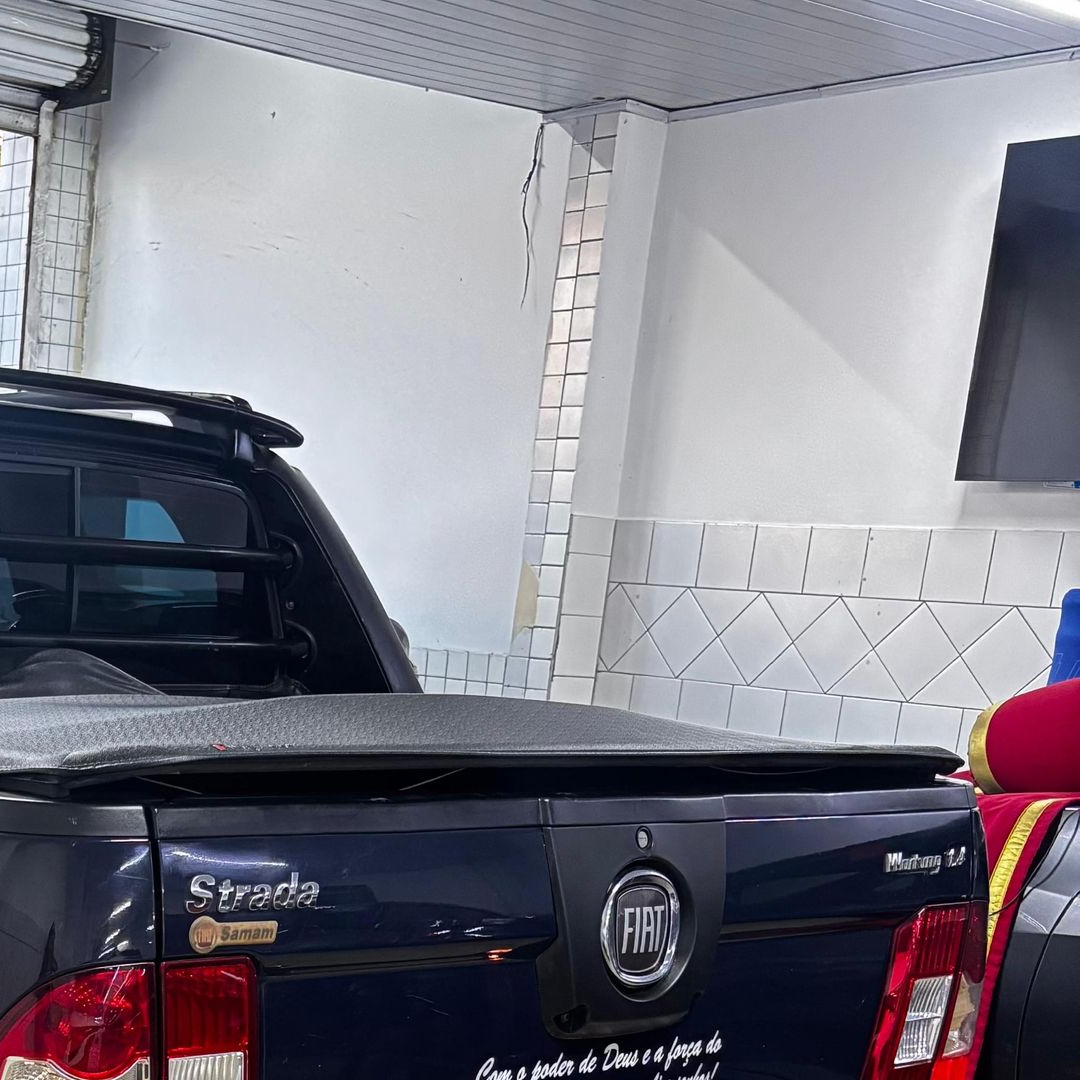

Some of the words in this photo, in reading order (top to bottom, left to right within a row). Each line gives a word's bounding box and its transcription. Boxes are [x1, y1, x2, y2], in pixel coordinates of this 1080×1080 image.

[186, 871, 320, 913] Strada
[220, 926, 274, 942] Samam
[621, 905, 665, 954] FIAT
[578, 1048, 597, 1074] de
[601, 1042, 639, 1072] Deus
[641, 1048, 651, 1066] e
[654, 1047, 664, 1063] a
[664, 1036, 703, 1072] força
[706, 1030, 722, 1054] do
